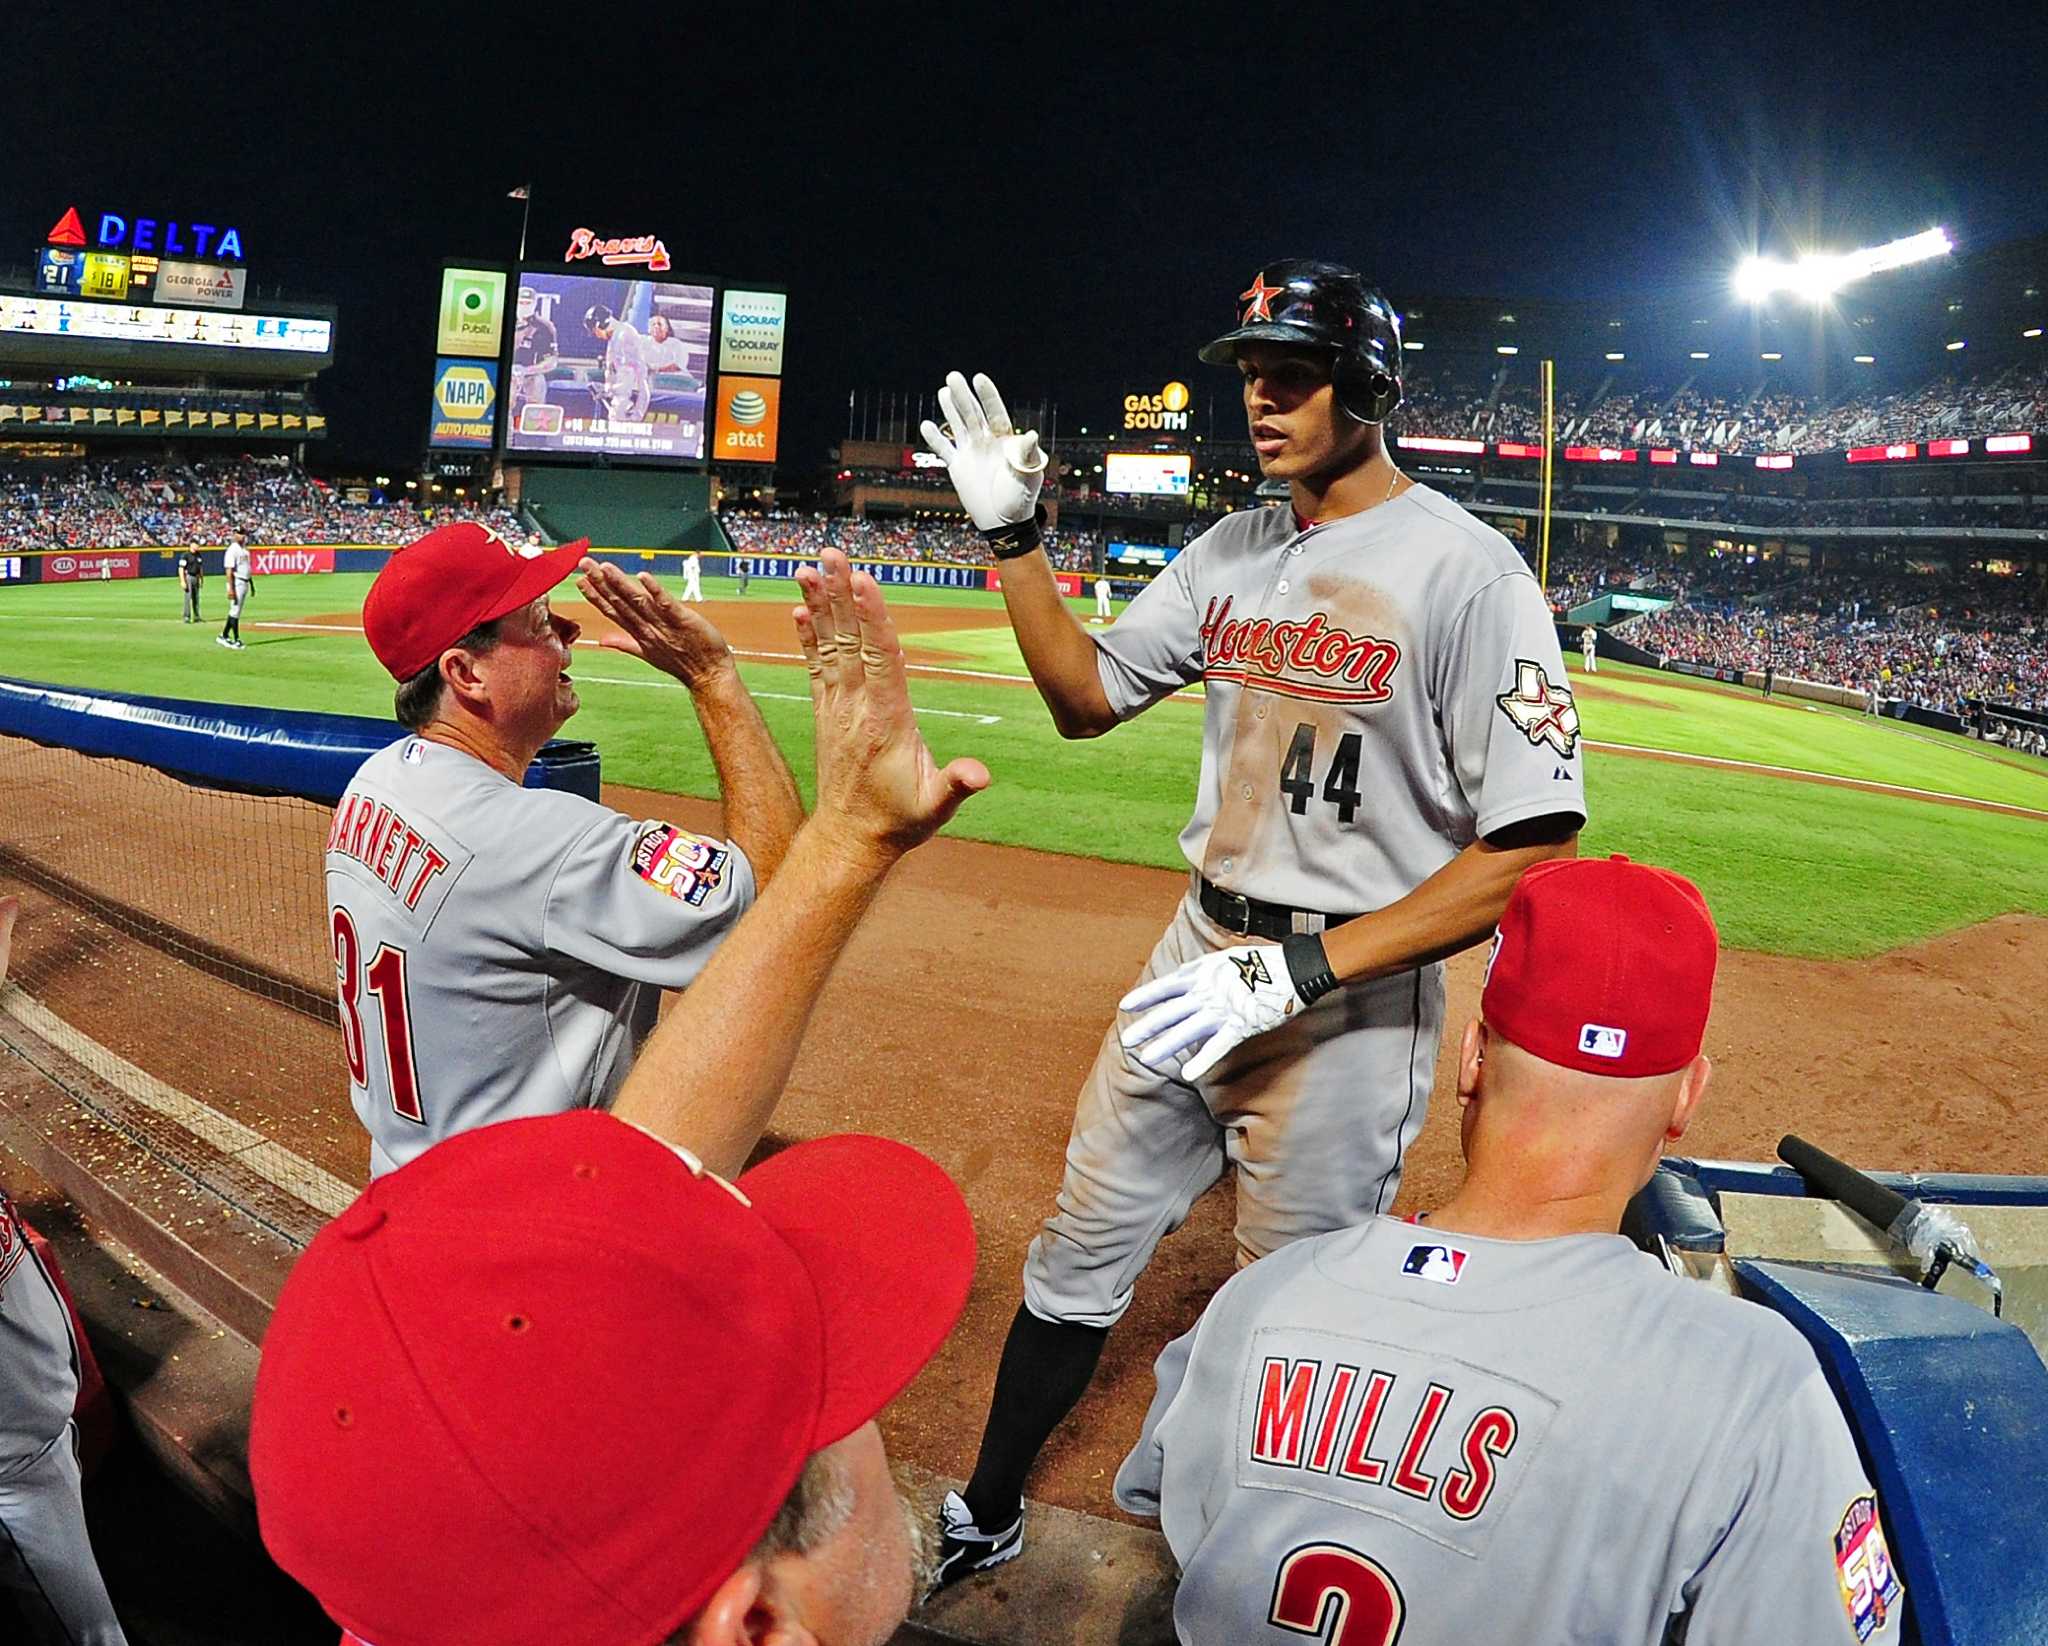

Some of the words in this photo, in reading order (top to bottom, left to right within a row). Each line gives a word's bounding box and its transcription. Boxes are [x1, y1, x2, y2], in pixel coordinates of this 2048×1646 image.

[99, 213, 243, 259] DELTA
[565, 228, 655, 262] Braves
[166, 274, 214, 287] GEORGIA
[197, 286, 234, 299] POWER
[444, 380, 486, 406] NAPA
[1124, 394, 1163, 412] GAS
[1124, 411, 1188, 430] SOUTH
[726, 430, 766, 448] at&t
[256, 550, 316, 574] xfinity
[892, 565, 969, 587] COUNTRY
[1200, 594, 1402, 697] Houston
[1280, 721, 1363, 824] 44
[636, 830, 669, 871] ASTROS
[650, 837, 711, 900] 50
[1250, 1356, 1519, 1522] MILLS
[1841, 1499, 1872, 1554] ASTROS
[1843, 1527, 1889, 1616] 50
